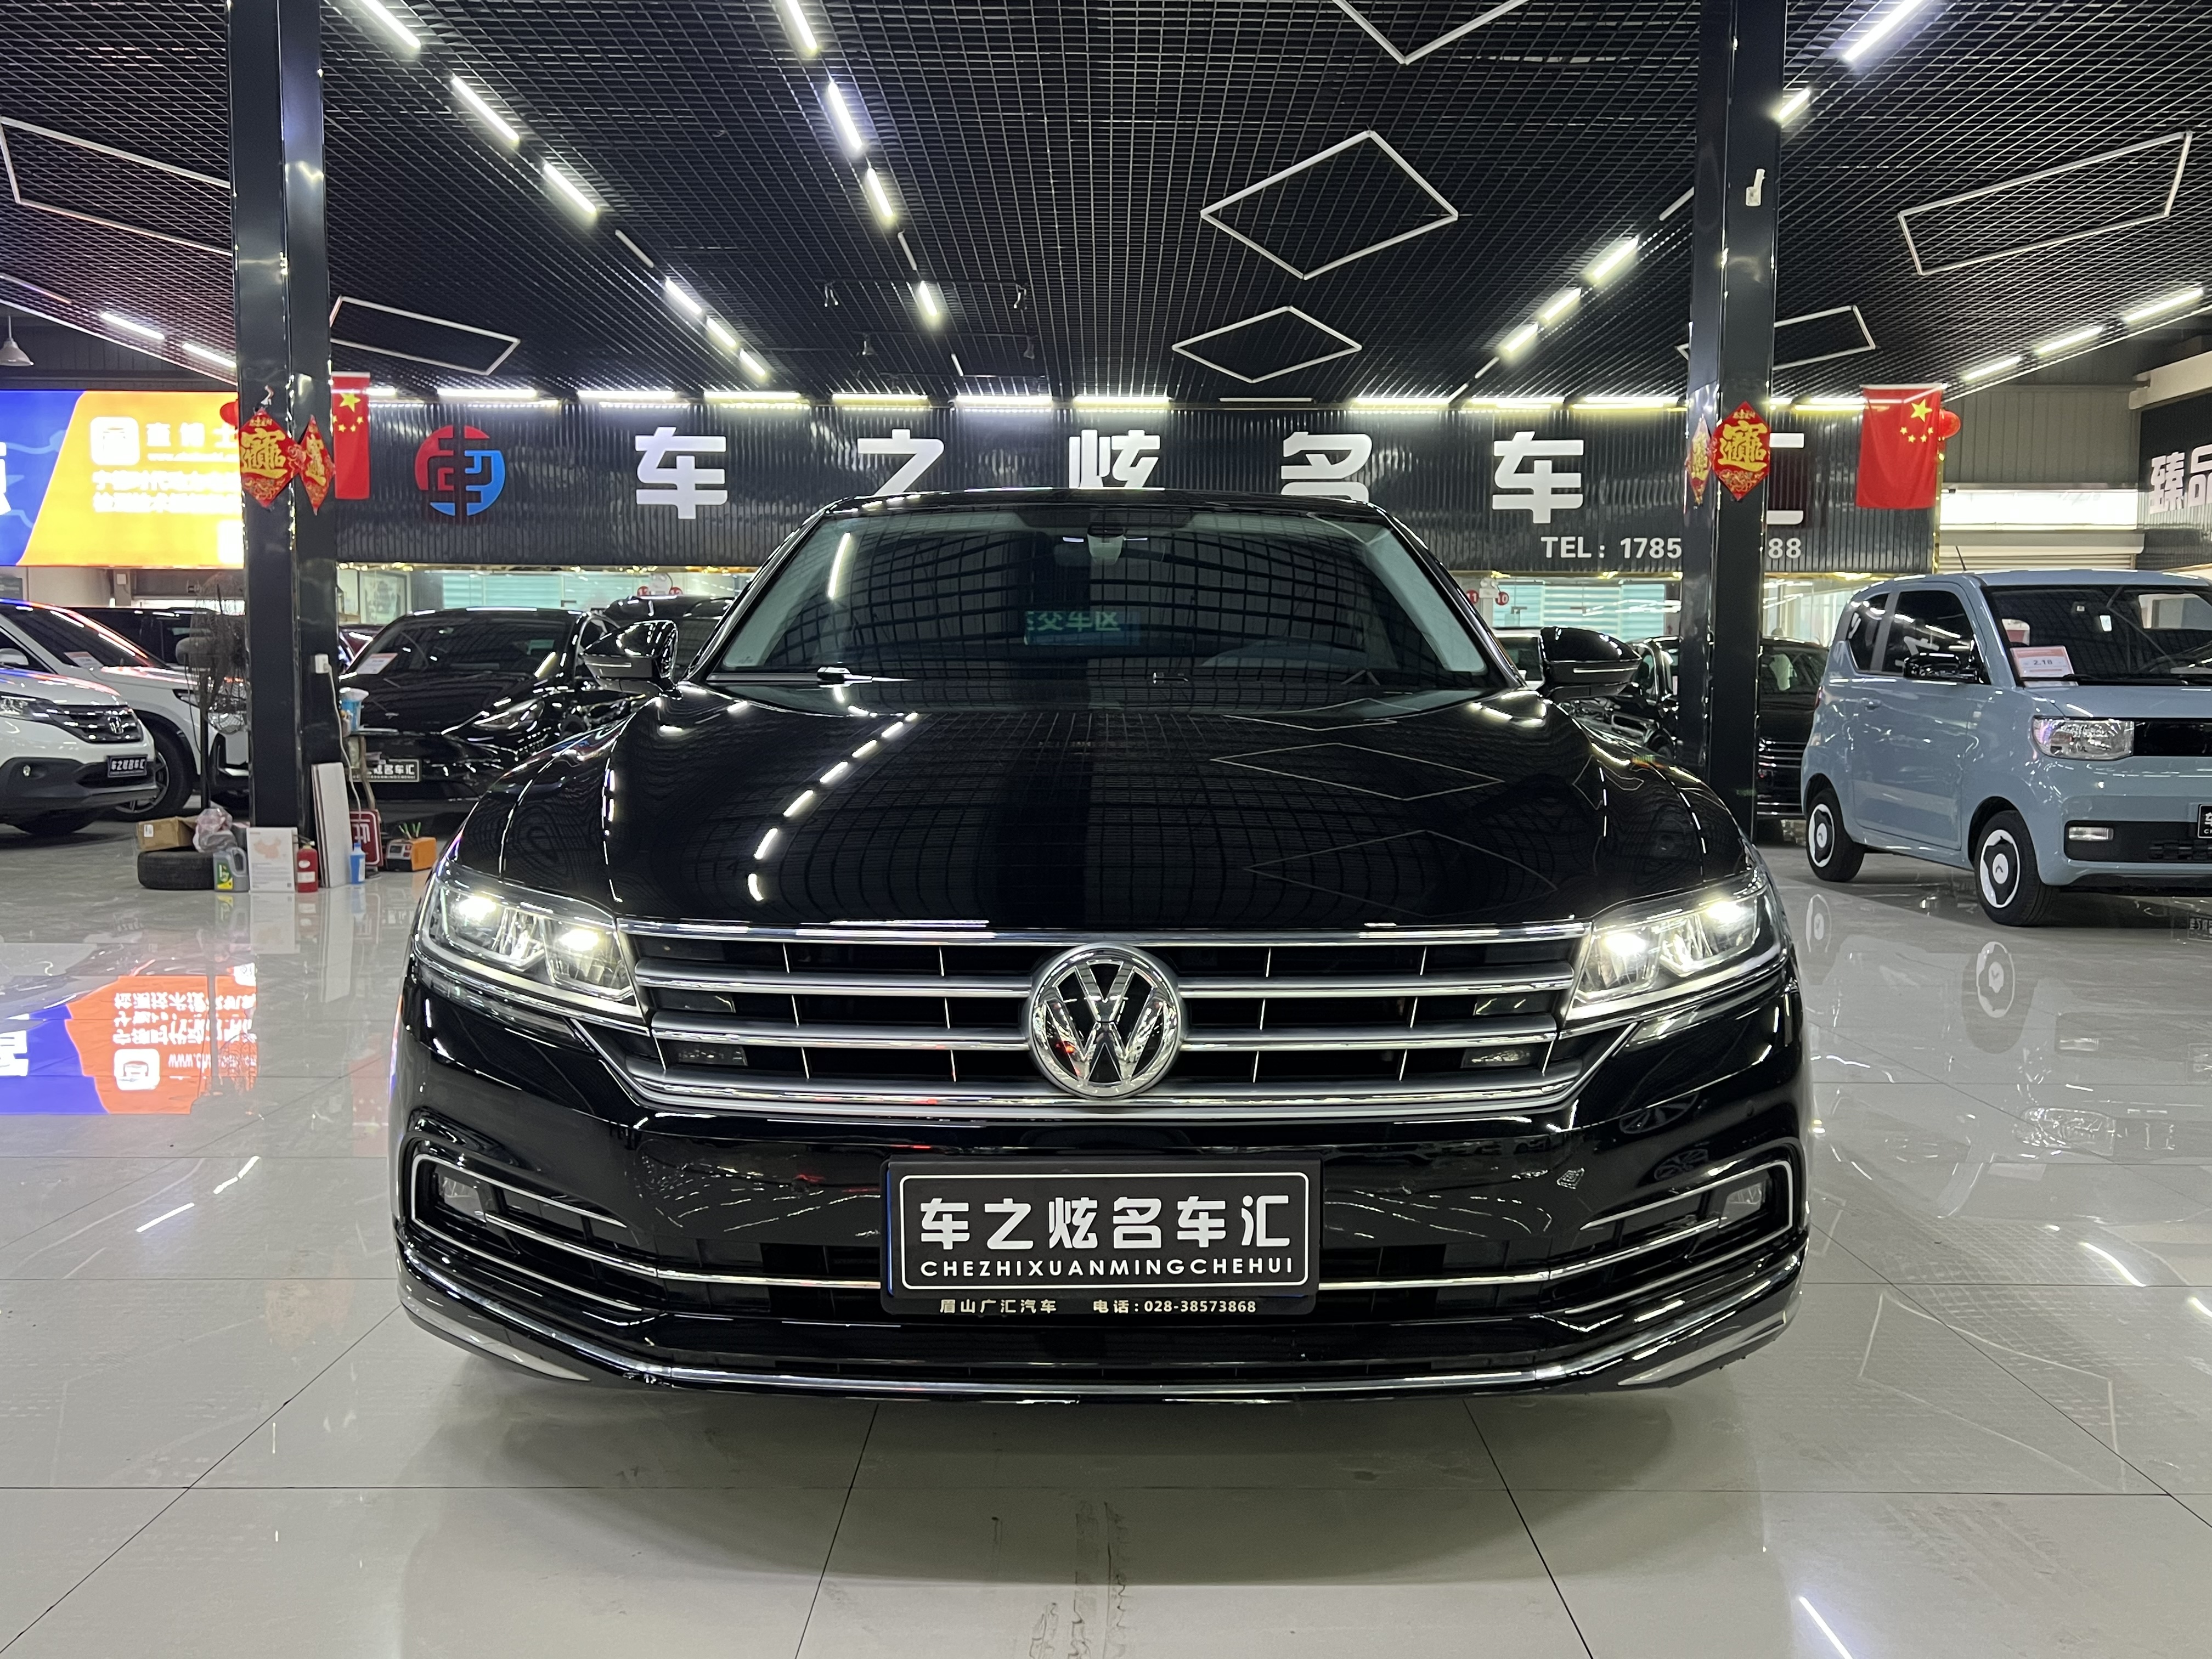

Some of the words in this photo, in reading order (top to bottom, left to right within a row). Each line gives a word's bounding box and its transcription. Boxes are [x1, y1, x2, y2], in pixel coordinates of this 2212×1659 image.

[920, 1194, 1291, 1250] 车之炫名车汇
[921, 1257, 1293, 1278] CHEZHIXUANMINGCHEHUI
[940, 1299, 1057, 1314] 眉山广汇汽车
